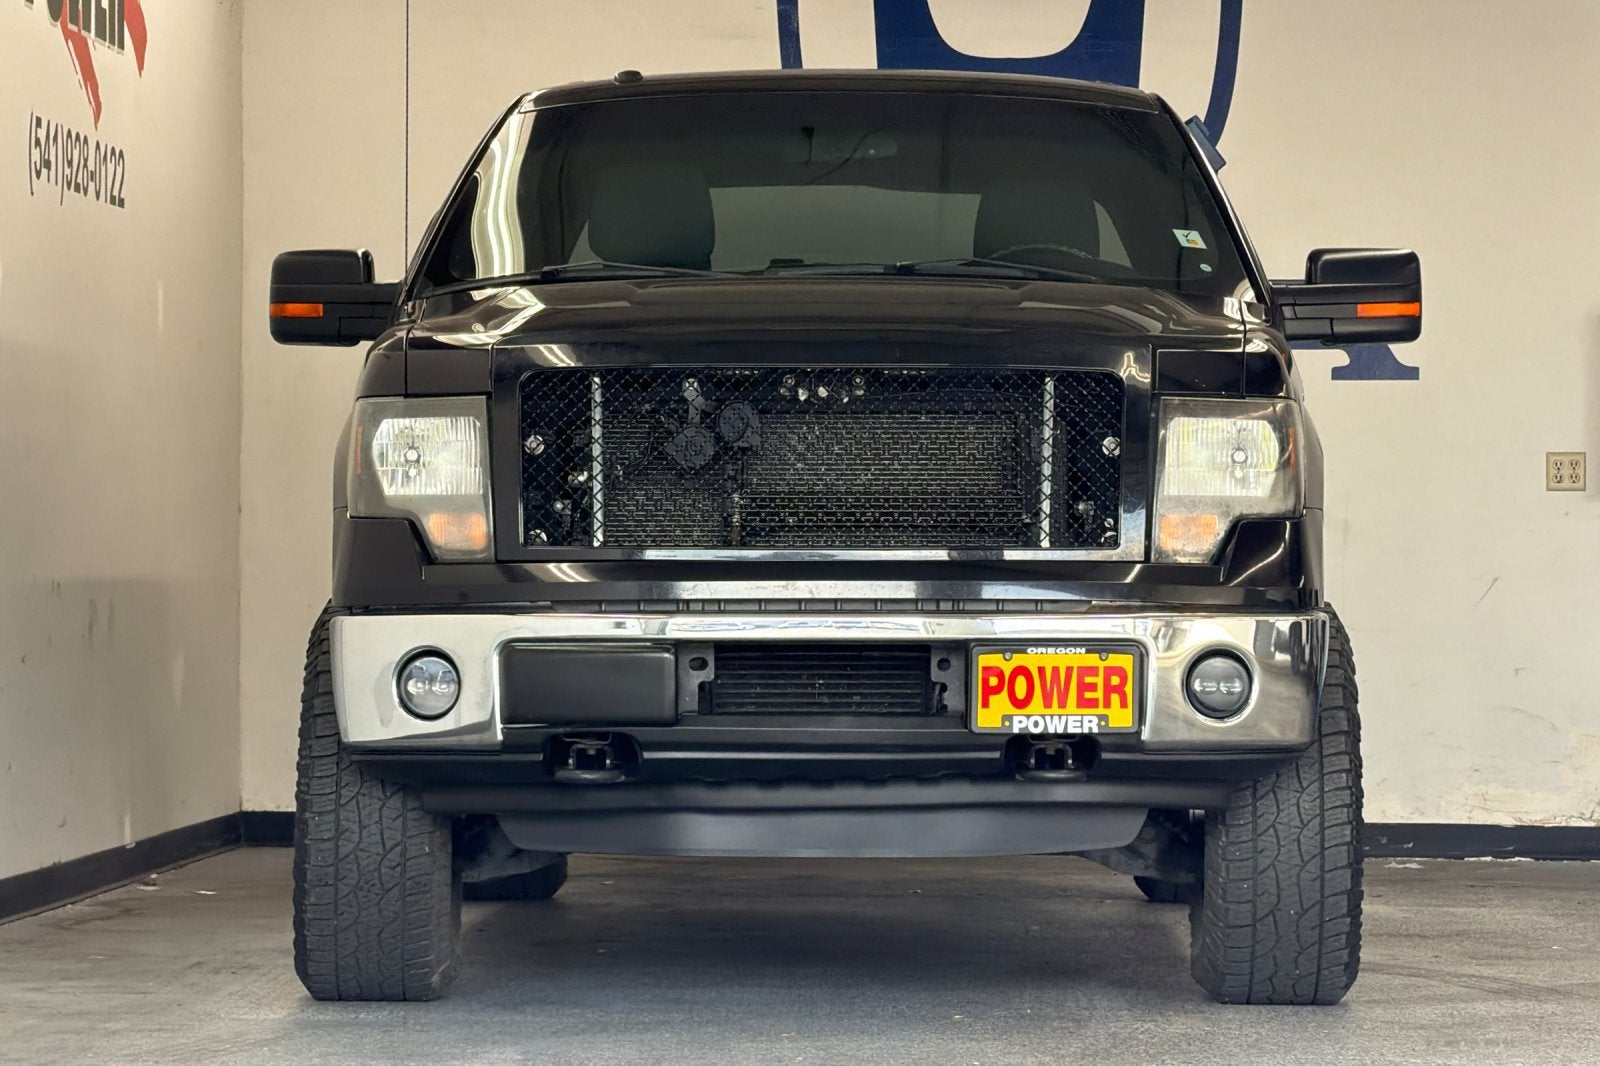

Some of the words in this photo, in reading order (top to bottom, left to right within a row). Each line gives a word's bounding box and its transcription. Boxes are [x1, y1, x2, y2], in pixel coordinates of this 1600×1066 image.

[29, 111, 125, 209] (541)928-0122
[981, 665, 1129, 710] POWER
[1012, 715, 1099, 733] POWER
